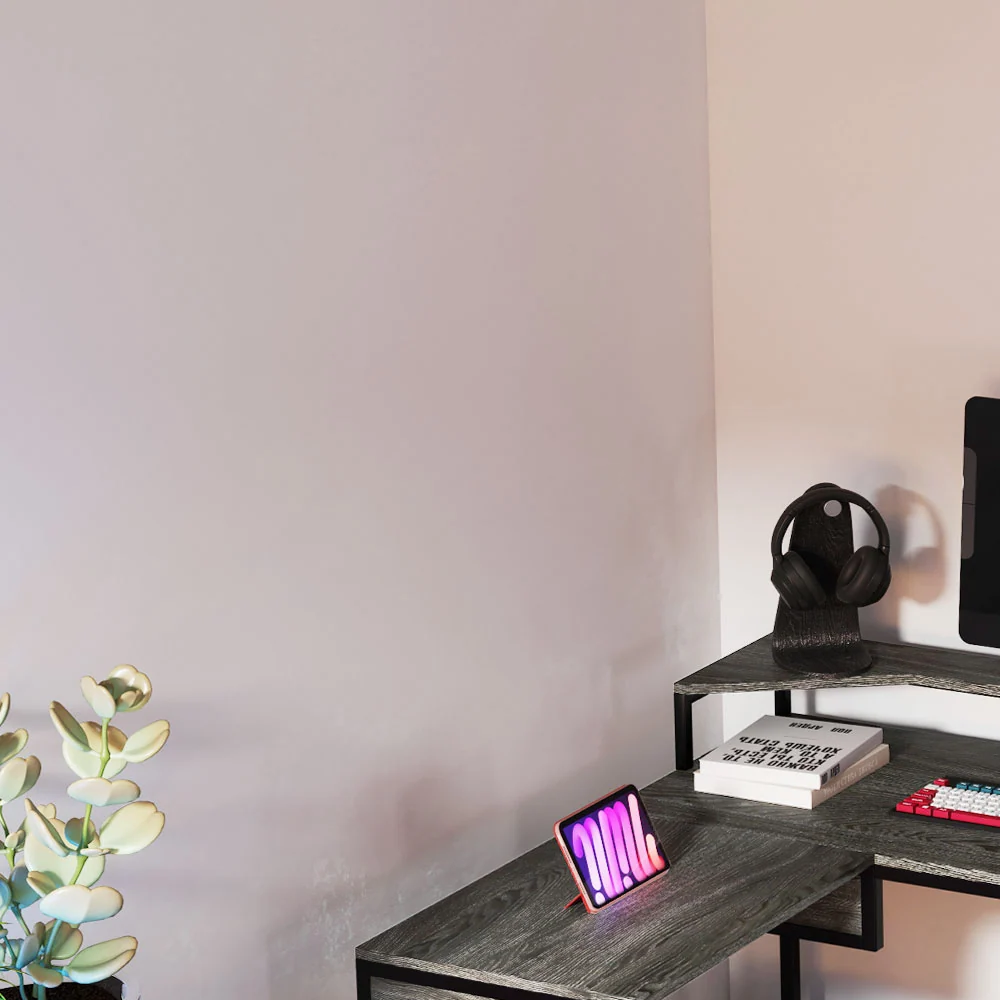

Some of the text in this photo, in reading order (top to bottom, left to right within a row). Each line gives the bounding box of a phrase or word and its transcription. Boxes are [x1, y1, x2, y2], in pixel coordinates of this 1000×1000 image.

[788, 722, 823, 731] АРДЕН
[738, 736, 842, 754] ХОЧЕШЬ СТАТЬ
[762, 746, 791, 754] КЕМ
[721, 753, 818, 772] ВАЖНО НЕ ТО,
[731, 748, 826, 766] КТО ТЫ ЕСТЬ,
